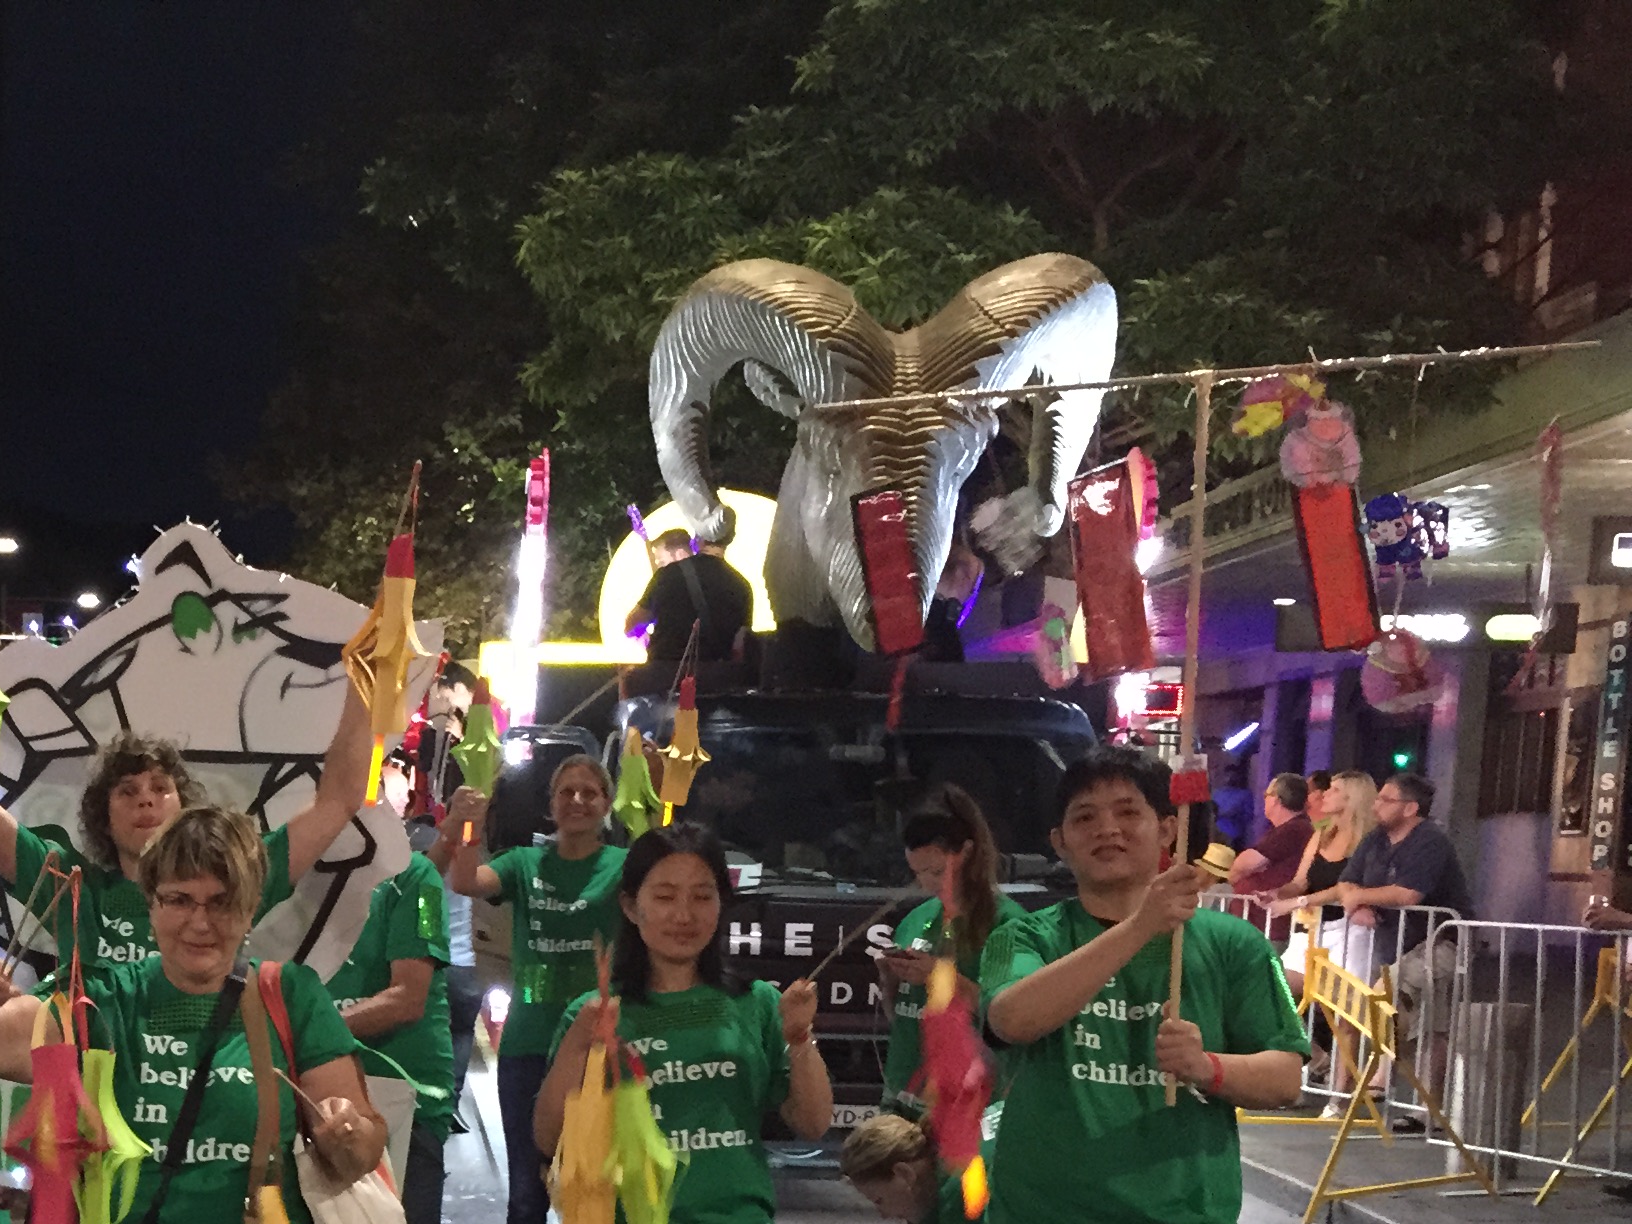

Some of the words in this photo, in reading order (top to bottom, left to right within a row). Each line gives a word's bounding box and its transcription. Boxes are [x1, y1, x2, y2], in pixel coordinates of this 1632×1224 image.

[1601, 620, 1628, 758] BOTTLE
[1591, 772, 1617, 862] SHOP
[142, 1033, 188, 1055] We
[1074, 1023, 1102, 1050] in
[133, 1096, 168, 1123] in
